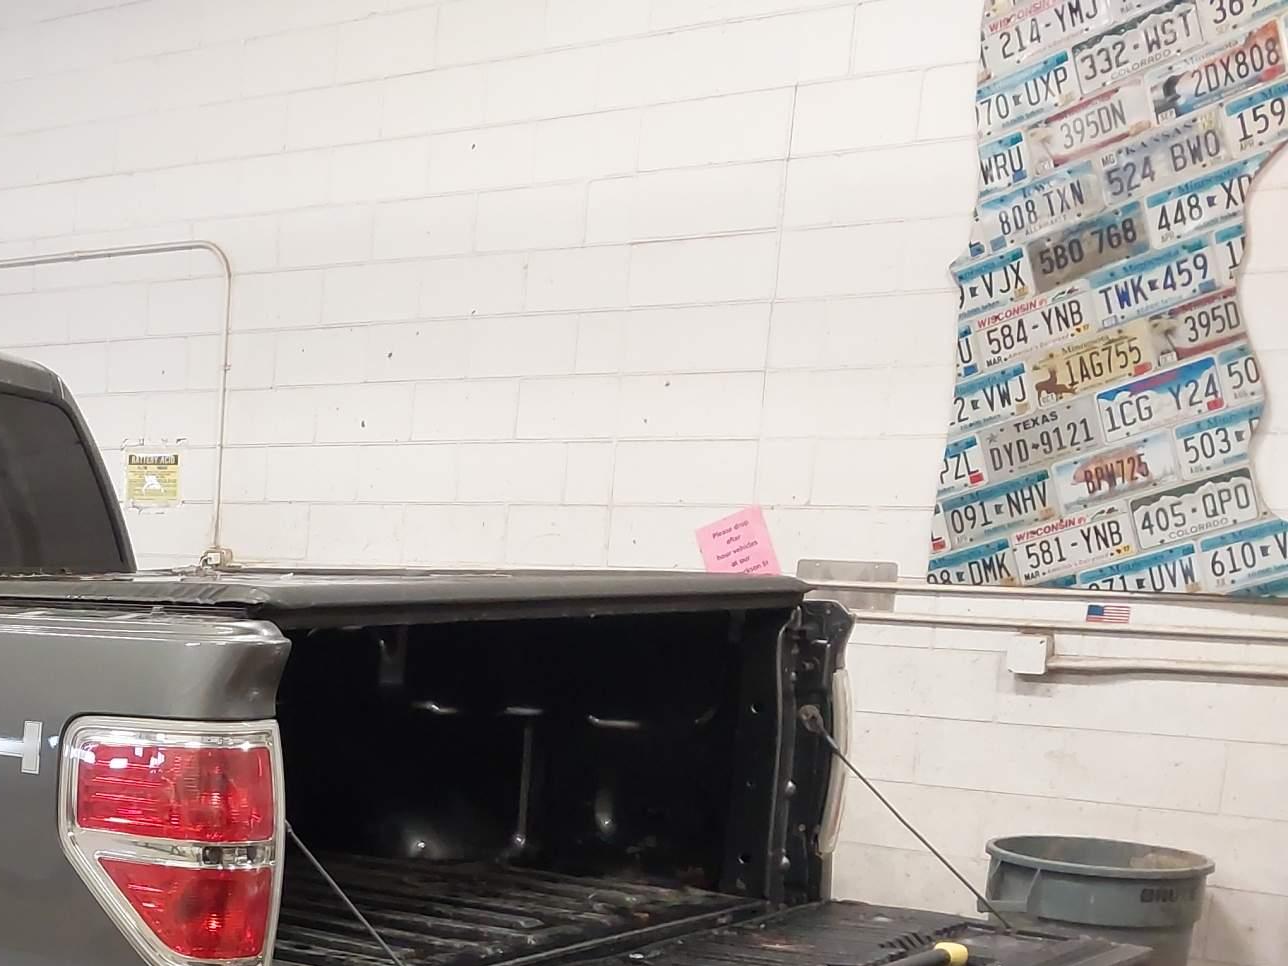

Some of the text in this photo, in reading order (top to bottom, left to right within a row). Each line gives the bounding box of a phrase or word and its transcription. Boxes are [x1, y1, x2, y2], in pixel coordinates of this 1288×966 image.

[999, 0, 1098, 59] 214-YMJ
[1191, 38, 1280, 98] 2DX808
[976, 92, 1010, 129] 70
[1024, 65, 1069, 107] UXP
[1060, 99, 1126, 149] 395DN
[980, 145, 1024, 186] WRU
[1105, 155, 1156, 196] 524
[998, 199, 1039, 236] 808
[1042, 179, 1085, 217] TXN
[1158, 193, 1203, 232] 448
[1090, 218, 1137, 254] 768
[981, 260, 1026, 299] VJX
[1099, 274, 1149, 315] TWK
[1162, 253, 1209, 292] 459
[977, 297, 1038, 329] WISCONSIN
[986, 299, 1084, 356] 584-YNB
[1064, 336, 1142, 387] 1AG755
[983, 375, 1027, 413] VWJ
[1105, 372, 1219, 433] 1CG Y24
[1013, 410, 1059, 434] TEXAS
[1039, 417, 1095, 455] 9121
[1183, 427, 1232, 465] 503
[950, 500, 993, 534] 091
[1006, 480, 1048, 518] NHV
[1015, 517, 1076, 542] WISCONSIN
[1025, 520, 1123, 569] 581-YNB
[1169, 517, 1229, 540] COLORADO
[1211, 541, 1257, 577] 610
